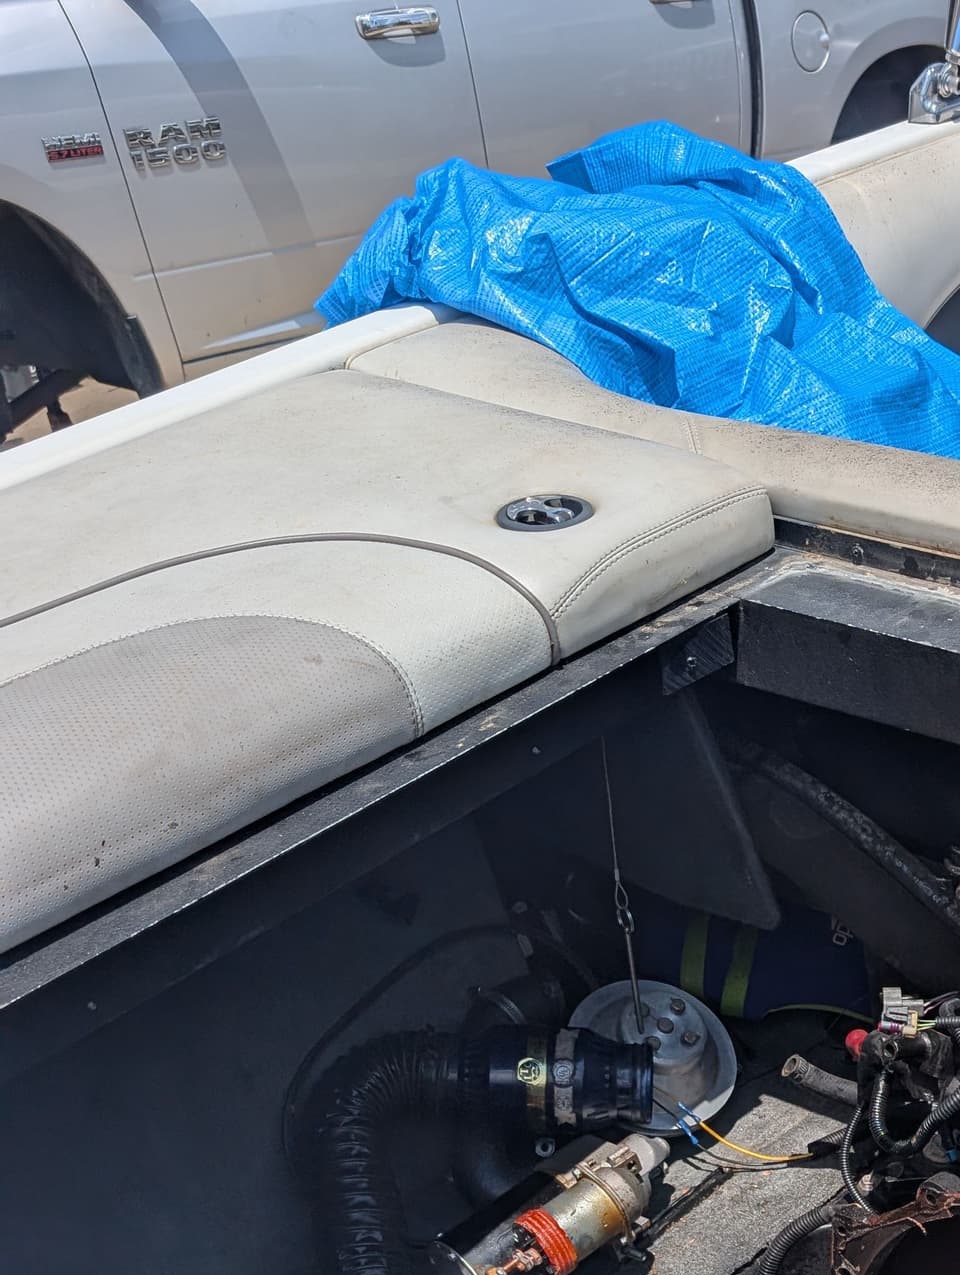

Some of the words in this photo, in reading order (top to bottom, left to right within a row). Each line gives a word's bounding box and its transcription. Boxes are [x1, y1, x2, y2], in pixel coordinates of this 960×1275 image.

[41, 132, 102, 150] HEMI
[123, 116, 222, 149] RAM
[70, 146, 102, 157] LITER
[130, 140, 226, 170] 1500
